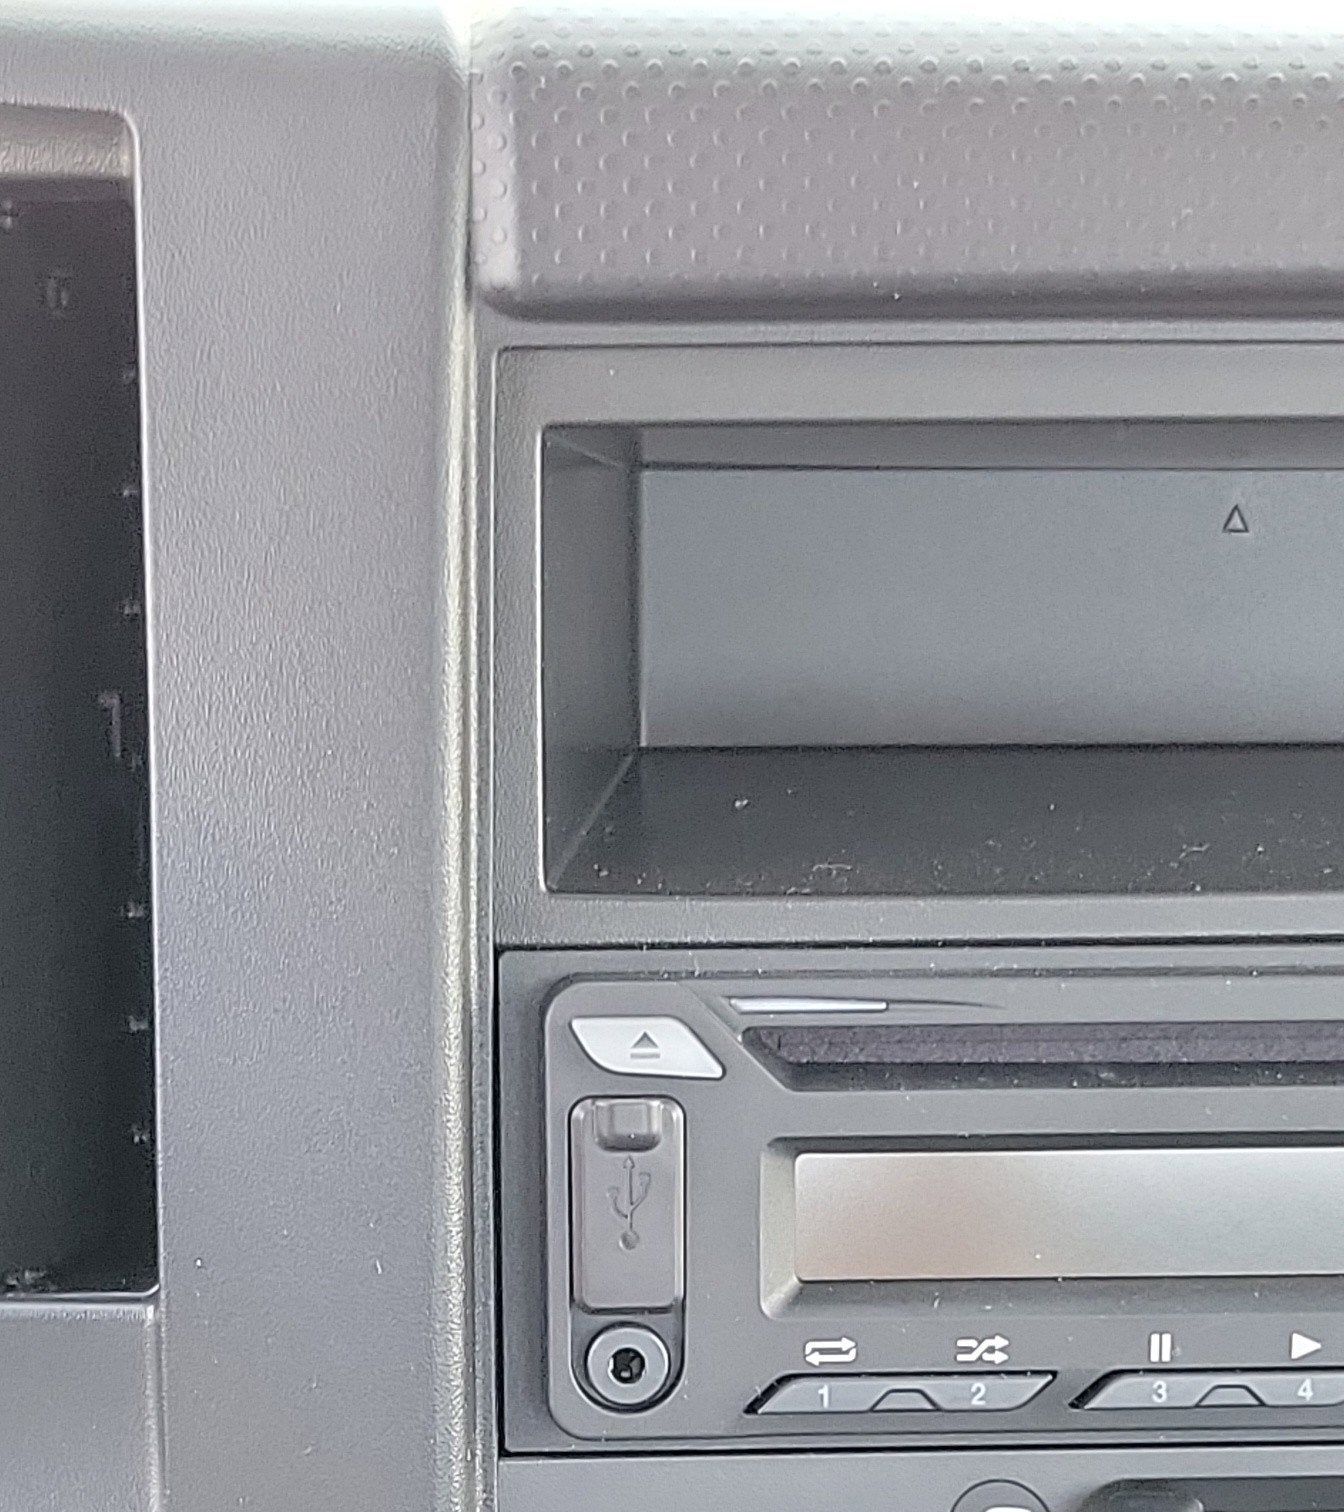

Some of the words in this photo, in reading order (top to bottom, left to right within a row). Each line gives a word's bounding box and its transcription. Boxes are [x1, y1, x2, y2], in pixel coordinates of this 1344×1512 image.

[817, 1384, 830, 1409] 1
[970, 1382, 987, 1406] 2
[1151, 1381, 1169, 1405] 3
[1296, 1378, 1315, 1401] 4
